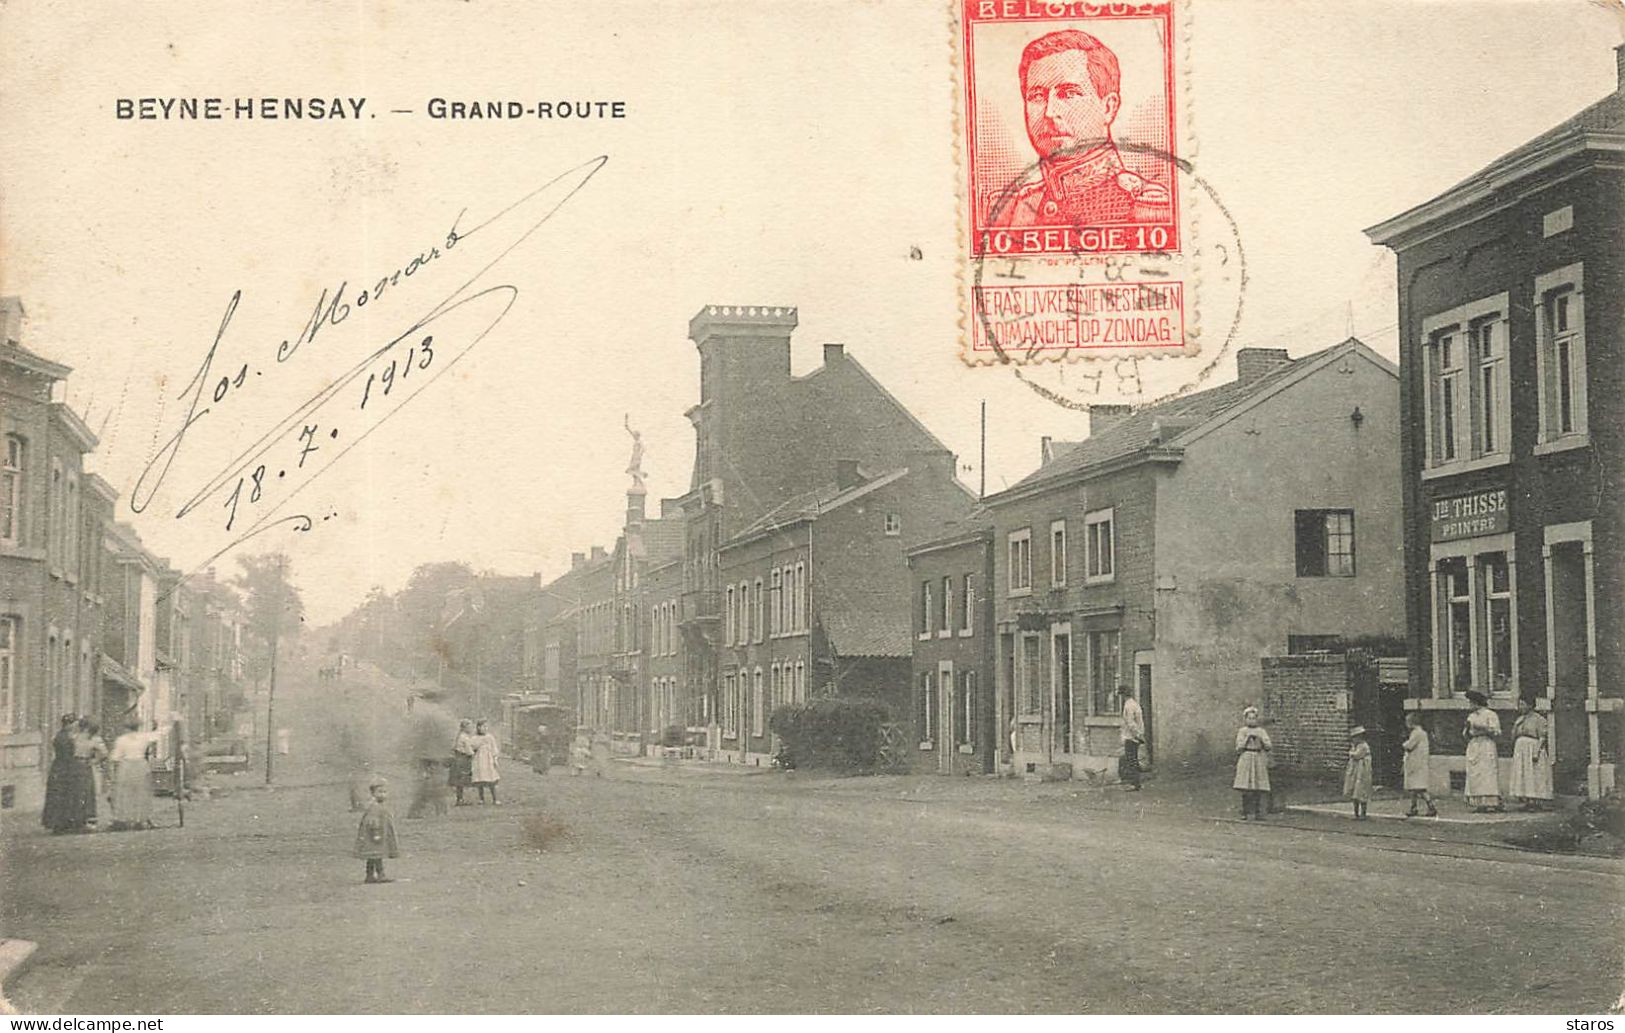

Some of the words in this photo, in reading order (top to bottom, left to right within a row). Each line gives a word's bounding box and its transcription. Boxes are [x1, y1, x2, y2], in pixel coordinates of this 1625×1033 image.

[983, 230, 1012, 253] 10
[1135, 226, 1168, 250] 10
[1081, 319, 1100, 344] OP
[1103, 316, 1170, 343] ZONDAG
[1453, 490, 1506, 518] THISSE
[1442, 516, 1496, 537] PEINTRE
